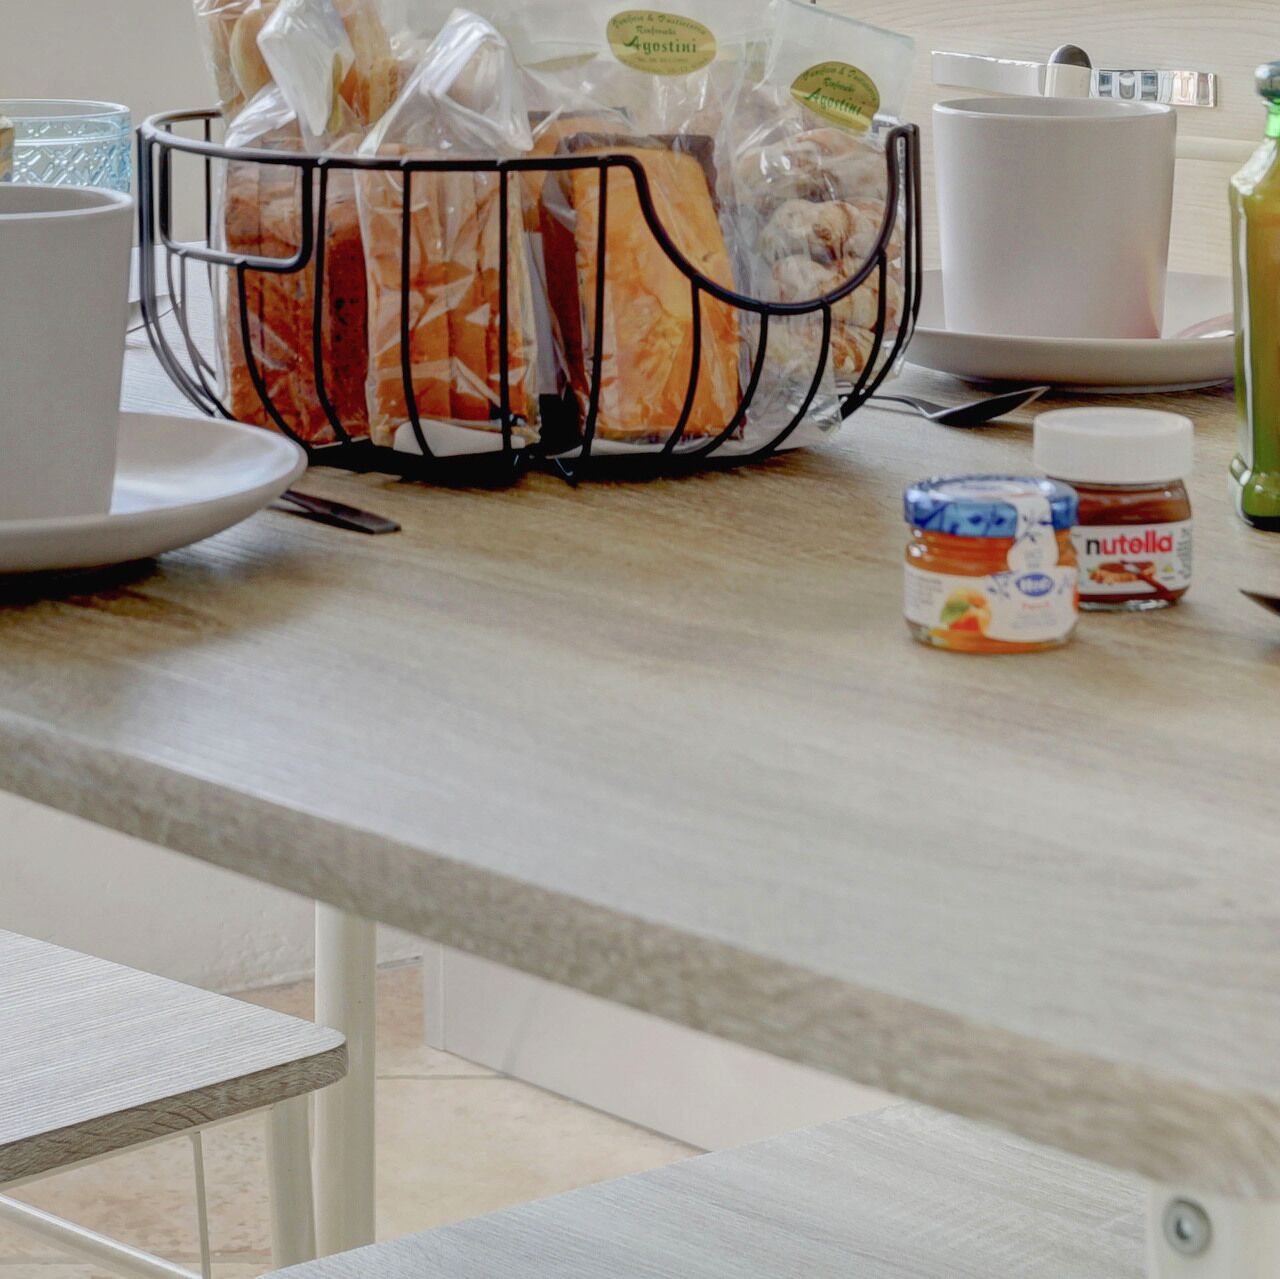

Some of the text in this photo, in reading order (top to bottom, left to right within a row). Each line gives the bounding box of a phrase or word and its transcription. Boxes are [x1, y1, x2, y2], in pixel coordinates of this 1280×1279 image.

[623, 35, 697, 55] Agostini
[804, 88, 866, 115] Agostini
[1086, 530, 1173, 555] nutella
